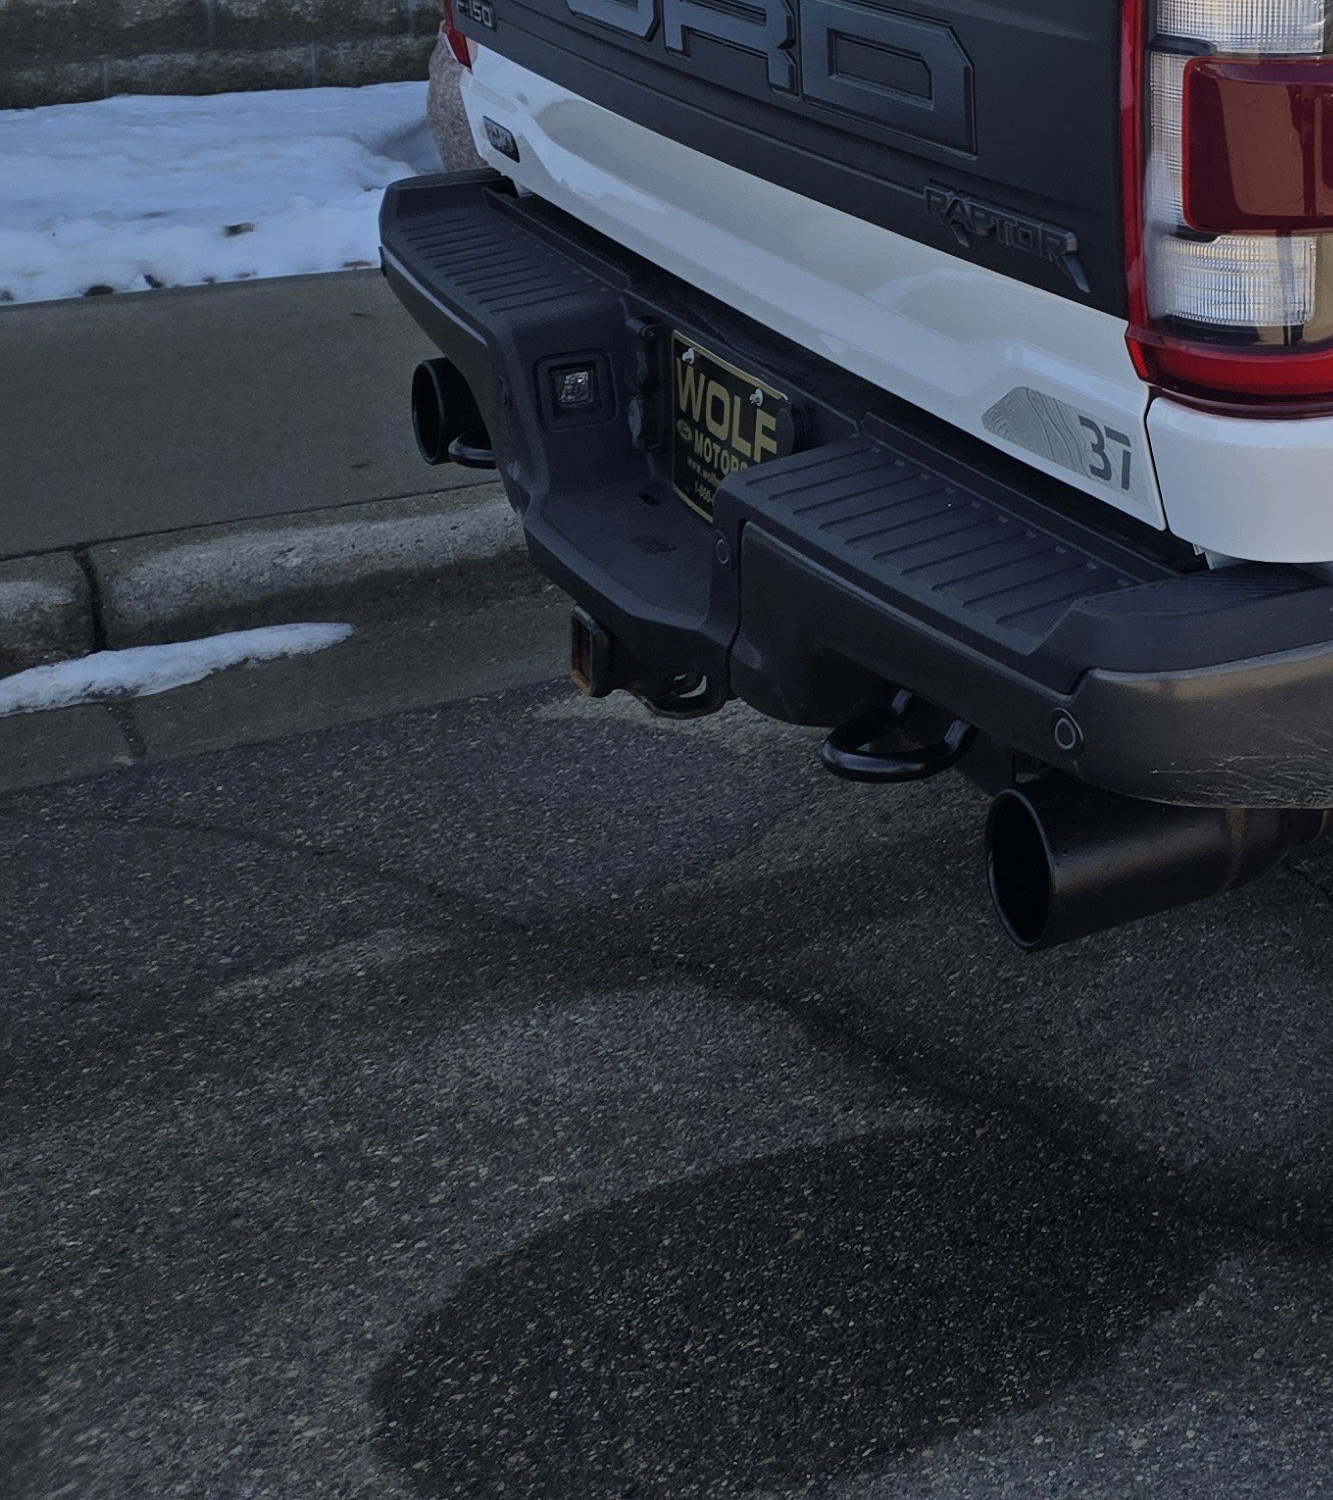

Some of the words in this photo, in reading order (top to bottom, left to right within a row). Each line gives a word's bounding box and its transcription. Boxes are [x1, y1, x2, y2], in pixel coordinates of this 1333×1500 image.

[923, 184, 1091, 293] RAPTOR
[676, 356, 778, 464] WOLF
[1078, 414, 1132, 491] 37
